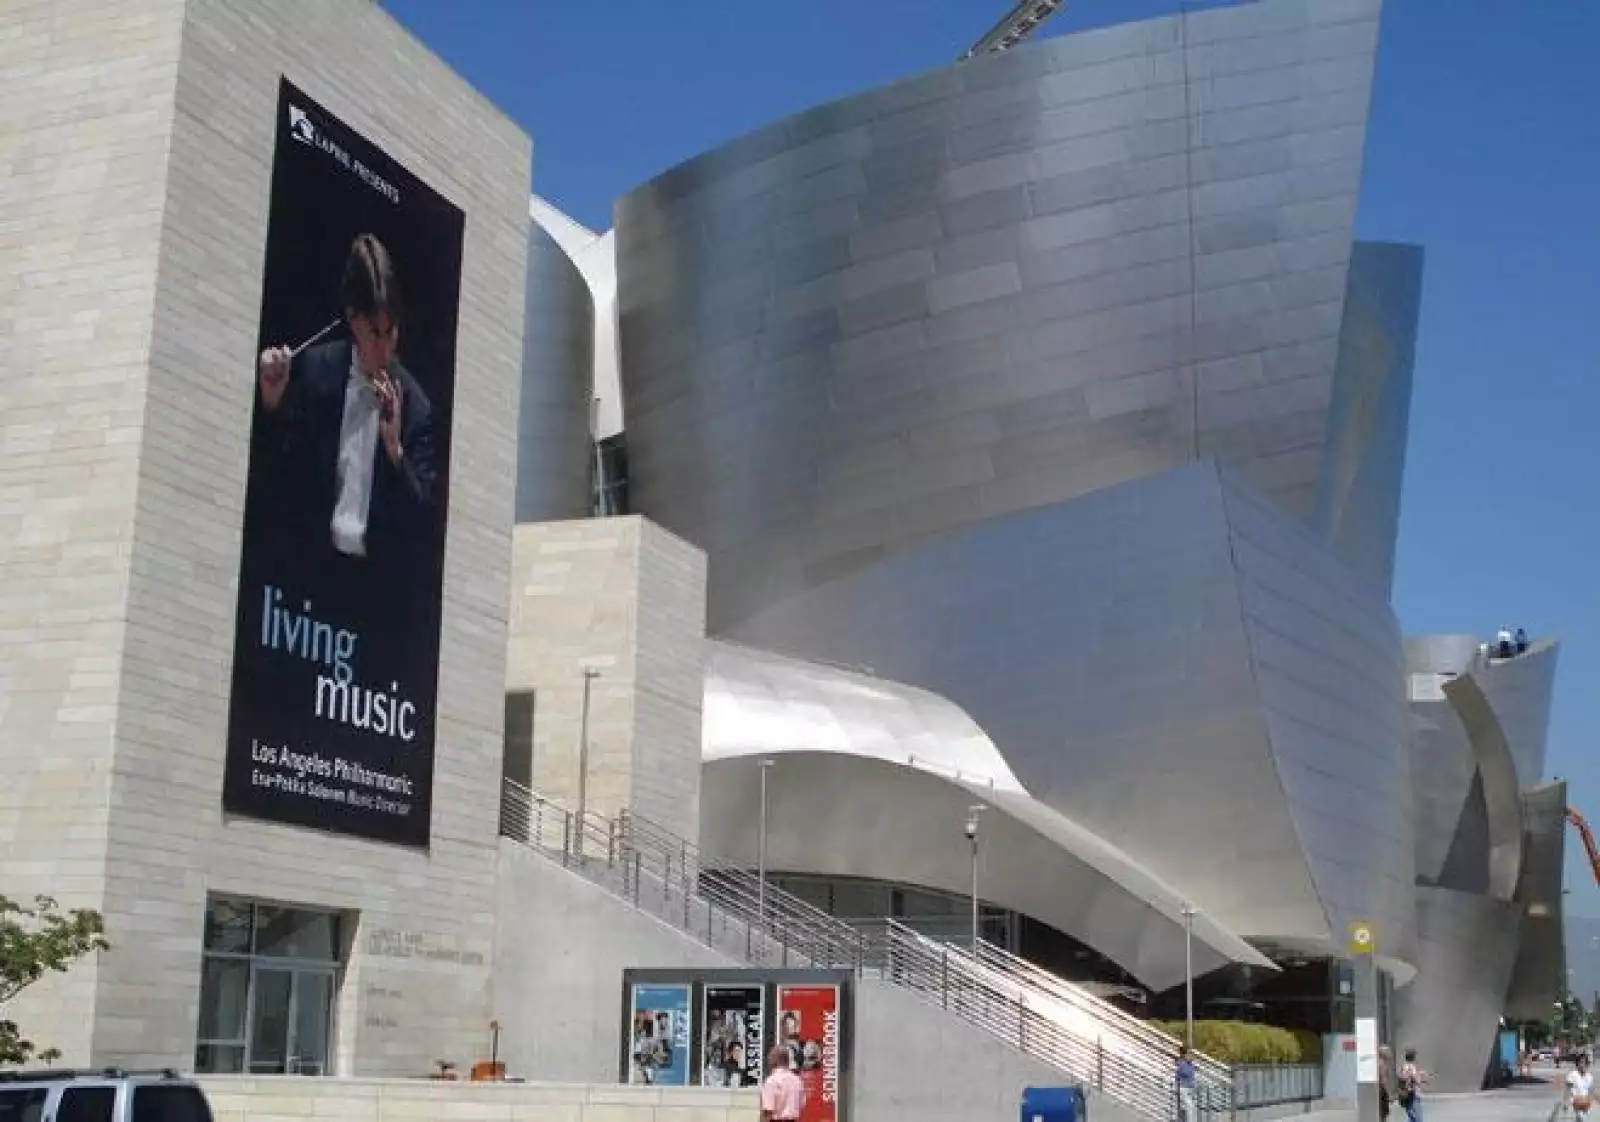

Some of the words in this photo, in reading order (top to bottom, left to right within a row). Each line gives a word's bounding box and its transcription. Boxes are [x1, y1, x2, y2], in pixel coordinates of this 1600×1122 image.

[262, 585, 357, 682] living
[314, 674, 416, 741] music
[252, 738, 278, 764] Los
[279, 745, 331, 778] Angeles
[822, 1010, 836, 1102] SONGBOOK
